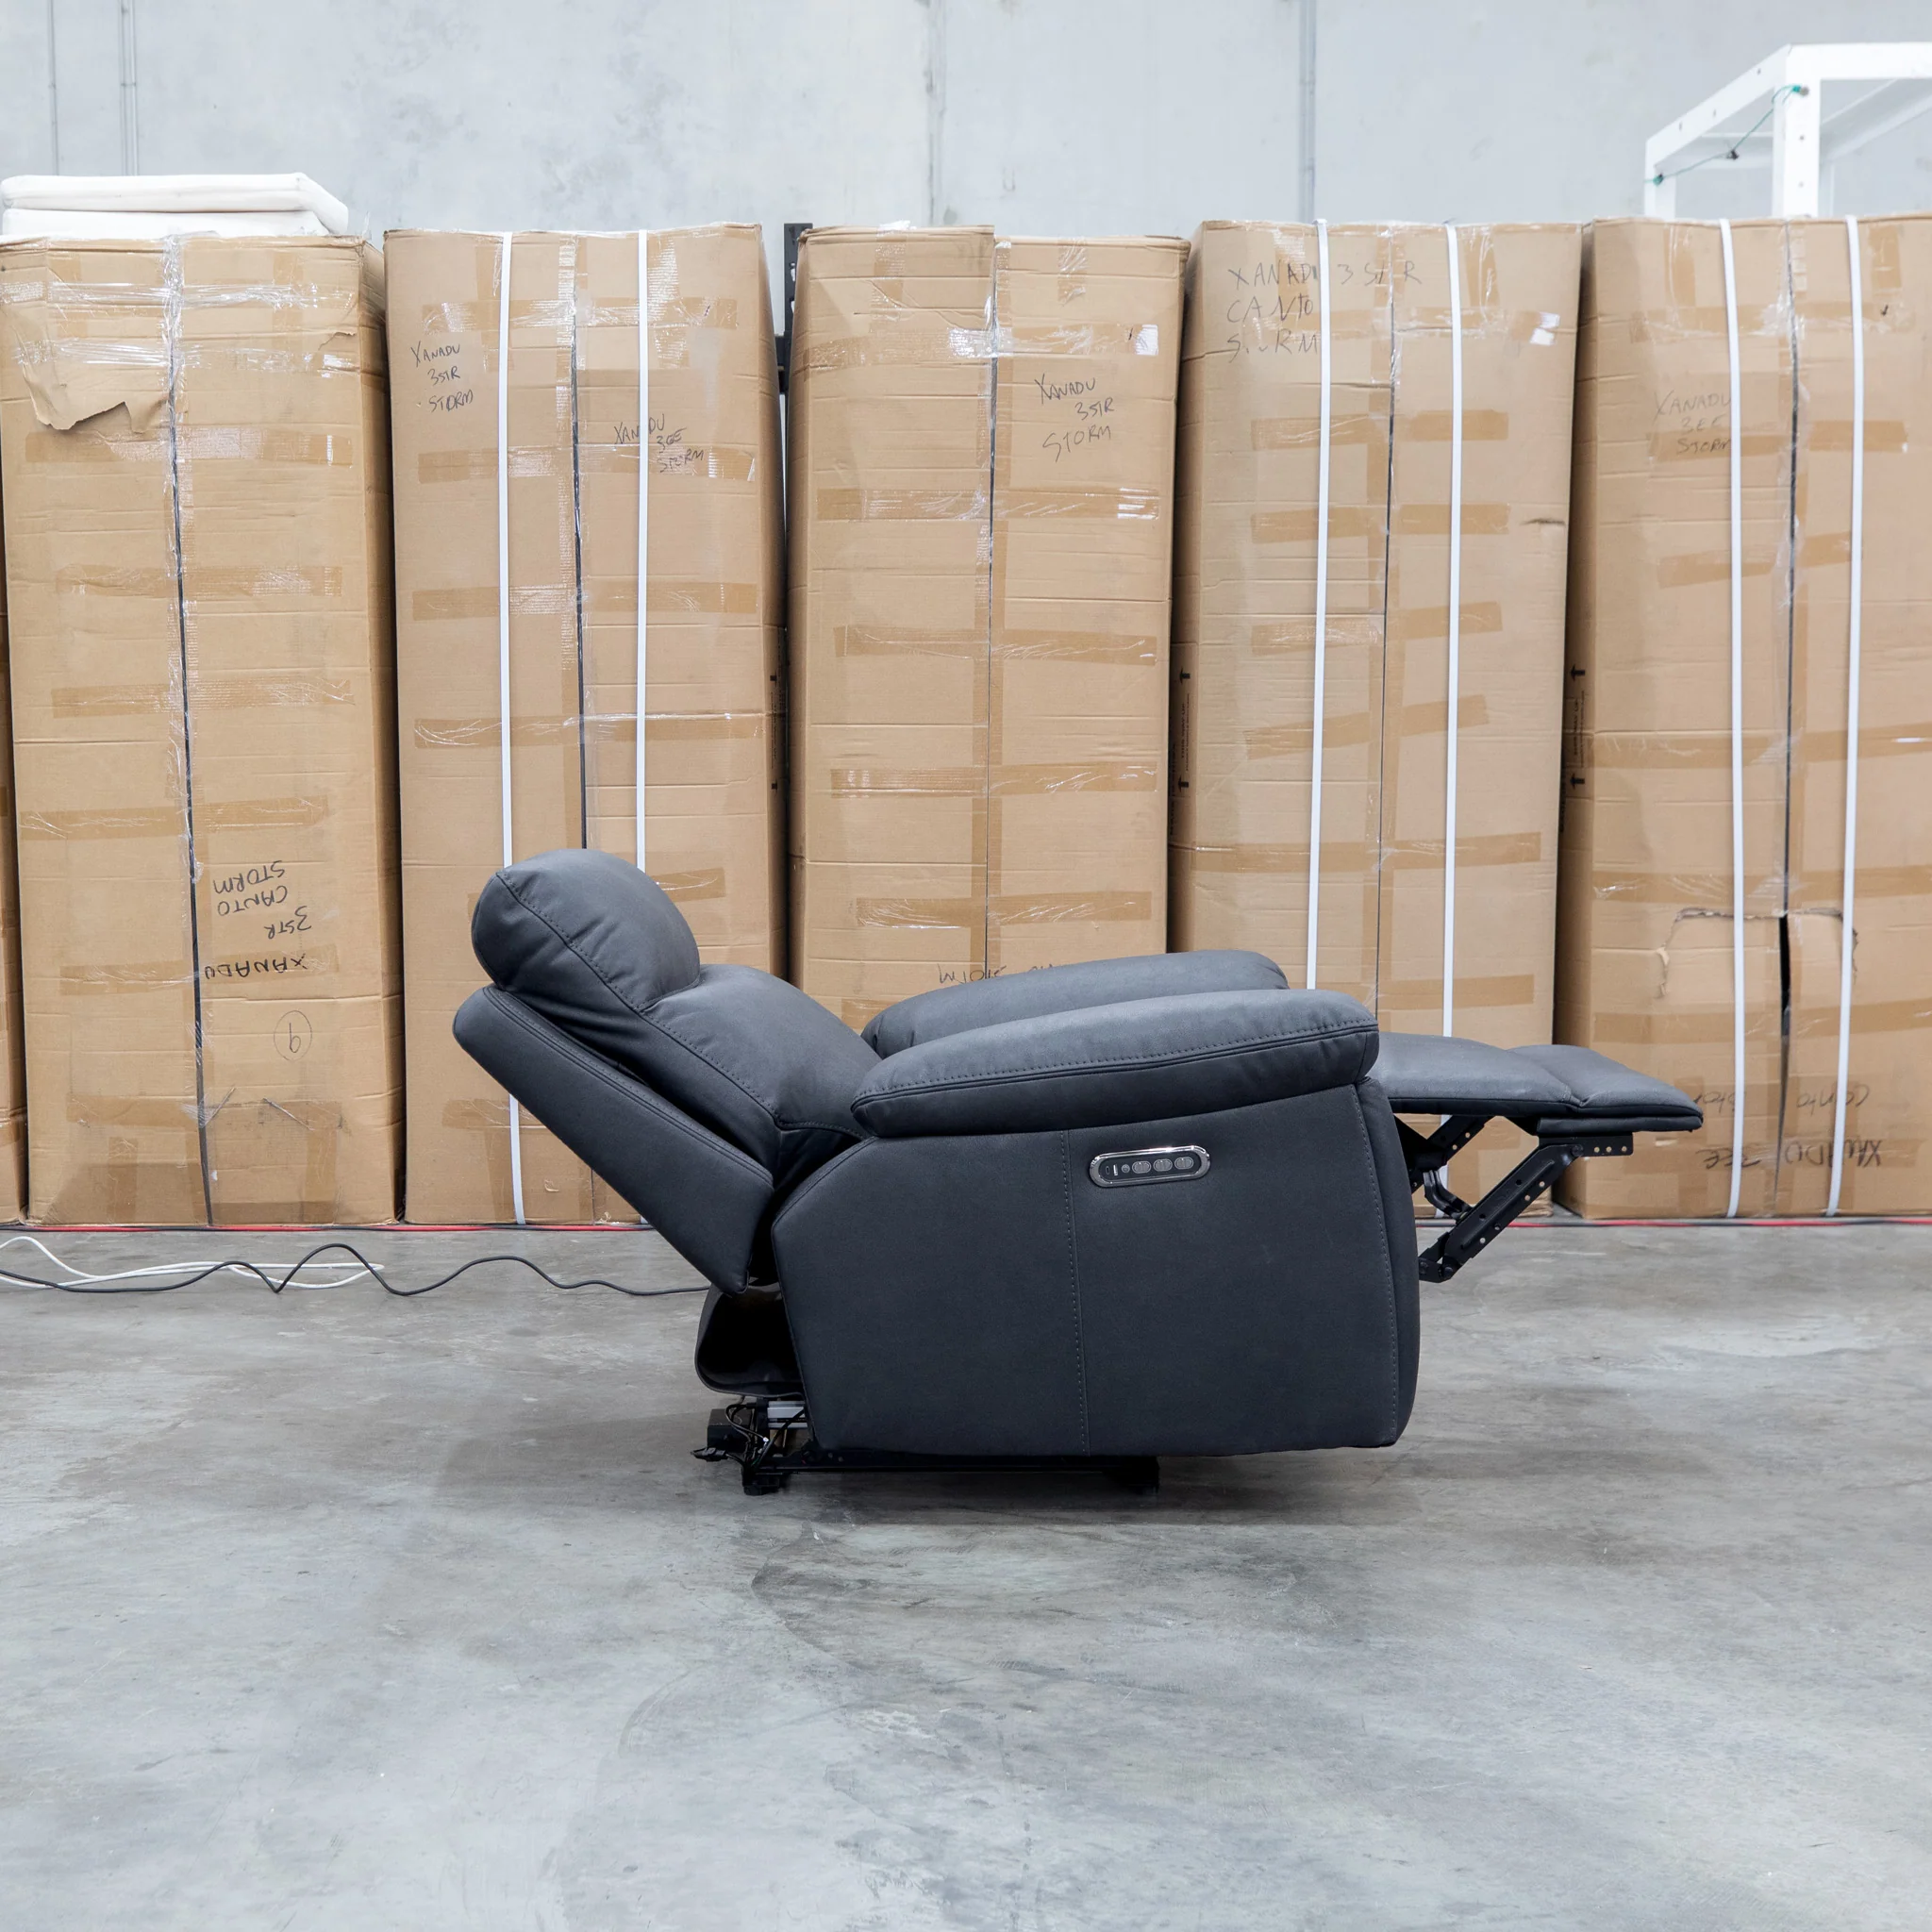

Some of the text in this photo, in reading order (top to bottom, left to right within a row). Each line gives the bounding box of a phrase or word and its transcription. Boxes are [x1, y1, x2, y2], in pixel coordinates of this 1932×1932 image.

[1227, 292, 1314, 323] CANTO
[410, 340, 461, 368] XANADU
[1226, 327, 1319, 364] SRM
[428, 389, 475, 413] STORM
[1034, 373, 1096, 405] XANADU
[613, 413, 665, 444] XANDU
[1042, 424, 1112, 463] STORM
[213, 860, 286, 894] STORM
[217, 885, 288, 916] CANTO
[204, 953, 308, 980] XANADU
